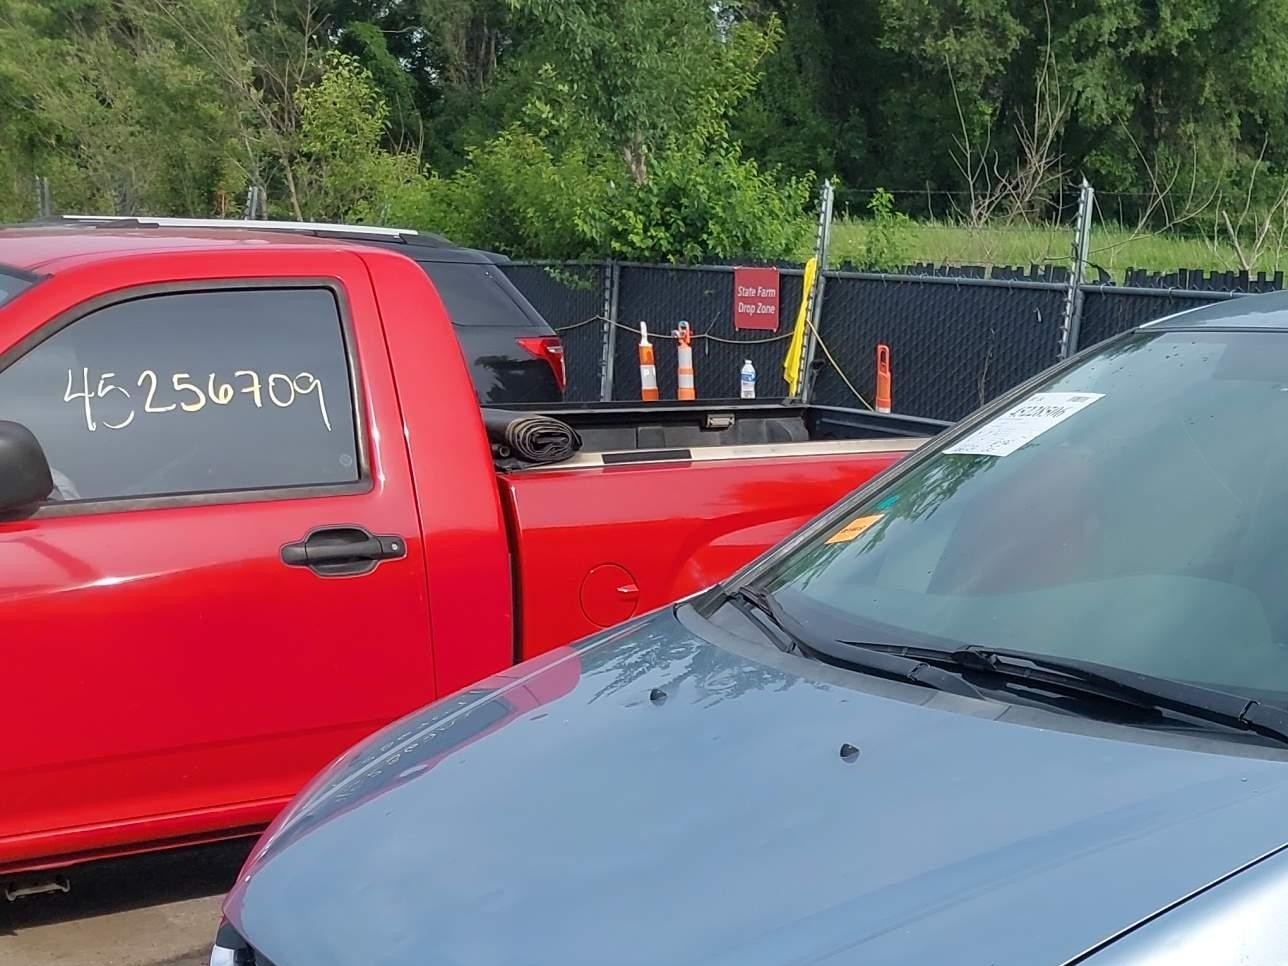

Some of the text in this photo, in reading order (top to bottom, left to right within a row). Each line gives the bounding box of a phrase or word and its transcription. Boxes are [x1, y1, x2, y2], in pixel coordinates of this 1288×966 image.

[737, 285, 776, 297] State Farm
[738, 302, 776, 316] Drop Zone
[63, 367, 332, 432] 45256709
